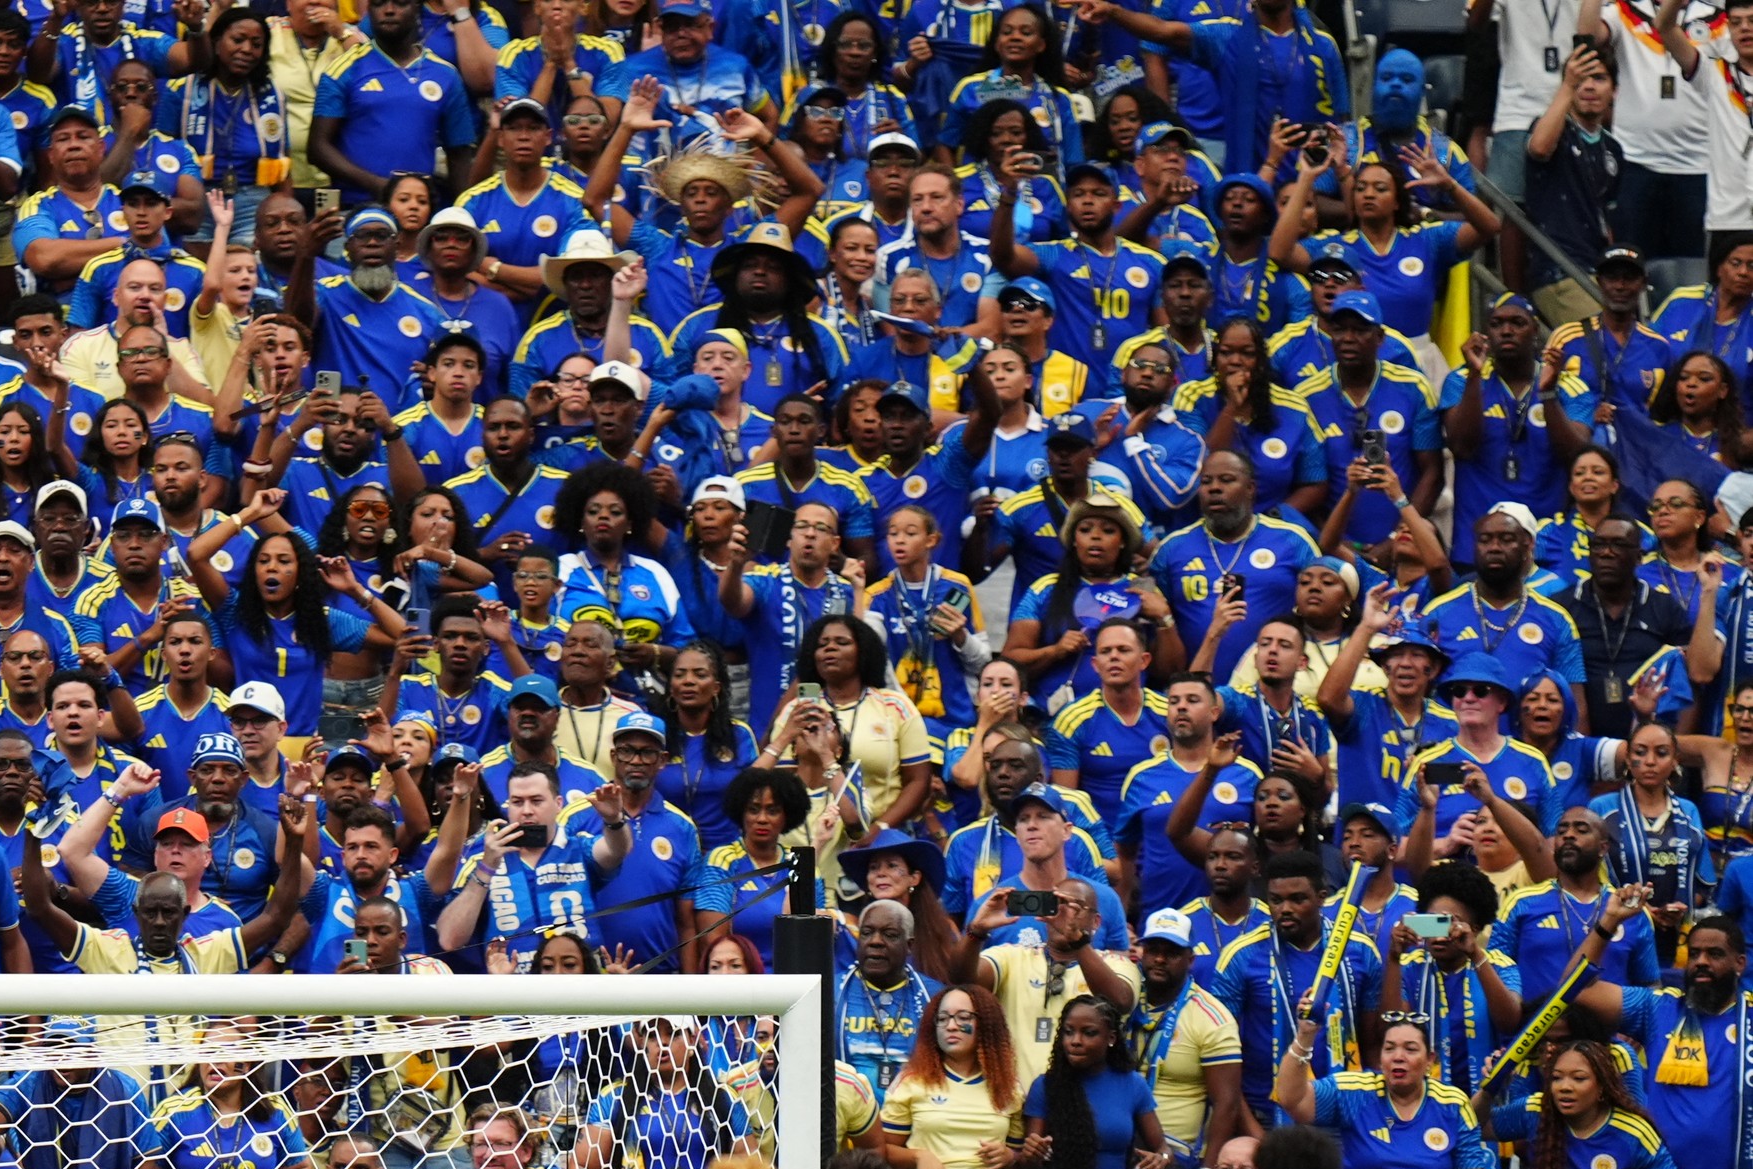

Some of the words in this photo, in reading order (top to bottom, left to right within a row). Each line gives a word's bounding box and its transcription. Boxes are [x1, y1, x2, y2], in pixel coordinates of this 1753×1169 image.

[1183, 575, 1208, 602] 10
[536, 873, 587, 887] CURAÇAO
[1325, 910, 1354, 969] Curaçao
[845, 1016, 917, 1037] URAÇ
[1516, 1004, 1562, 1055] Curaçao
